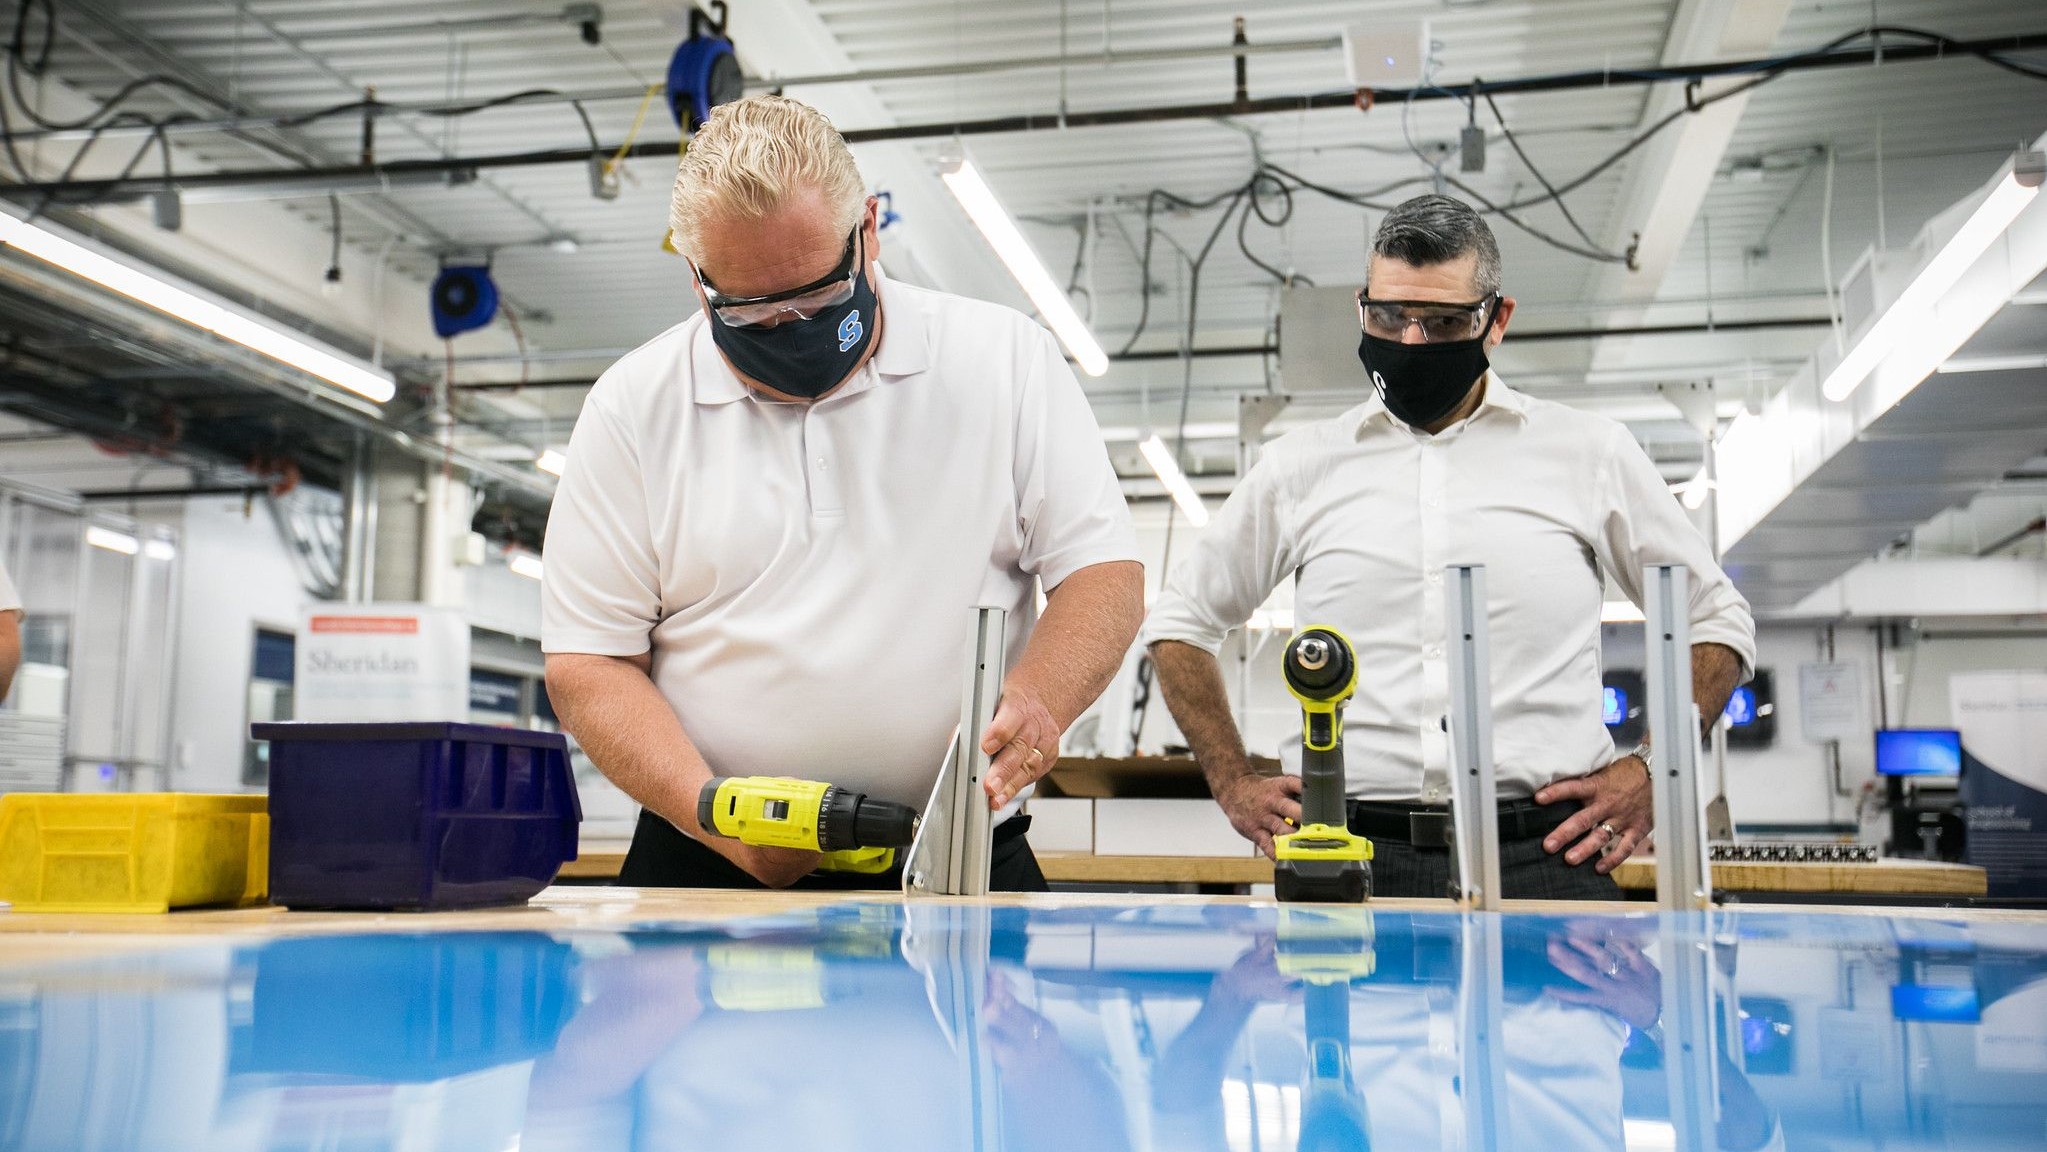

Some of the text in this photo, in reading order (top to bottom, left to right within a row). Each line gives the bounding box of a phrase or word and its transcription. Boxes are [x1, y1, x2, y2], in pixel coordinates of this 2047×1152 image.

[838, 310, 863, 352] S
[306, 649, 419, 674] Sheridan
[821, 803, 828, 812] 16
[819, 821, 826, 829] 18
